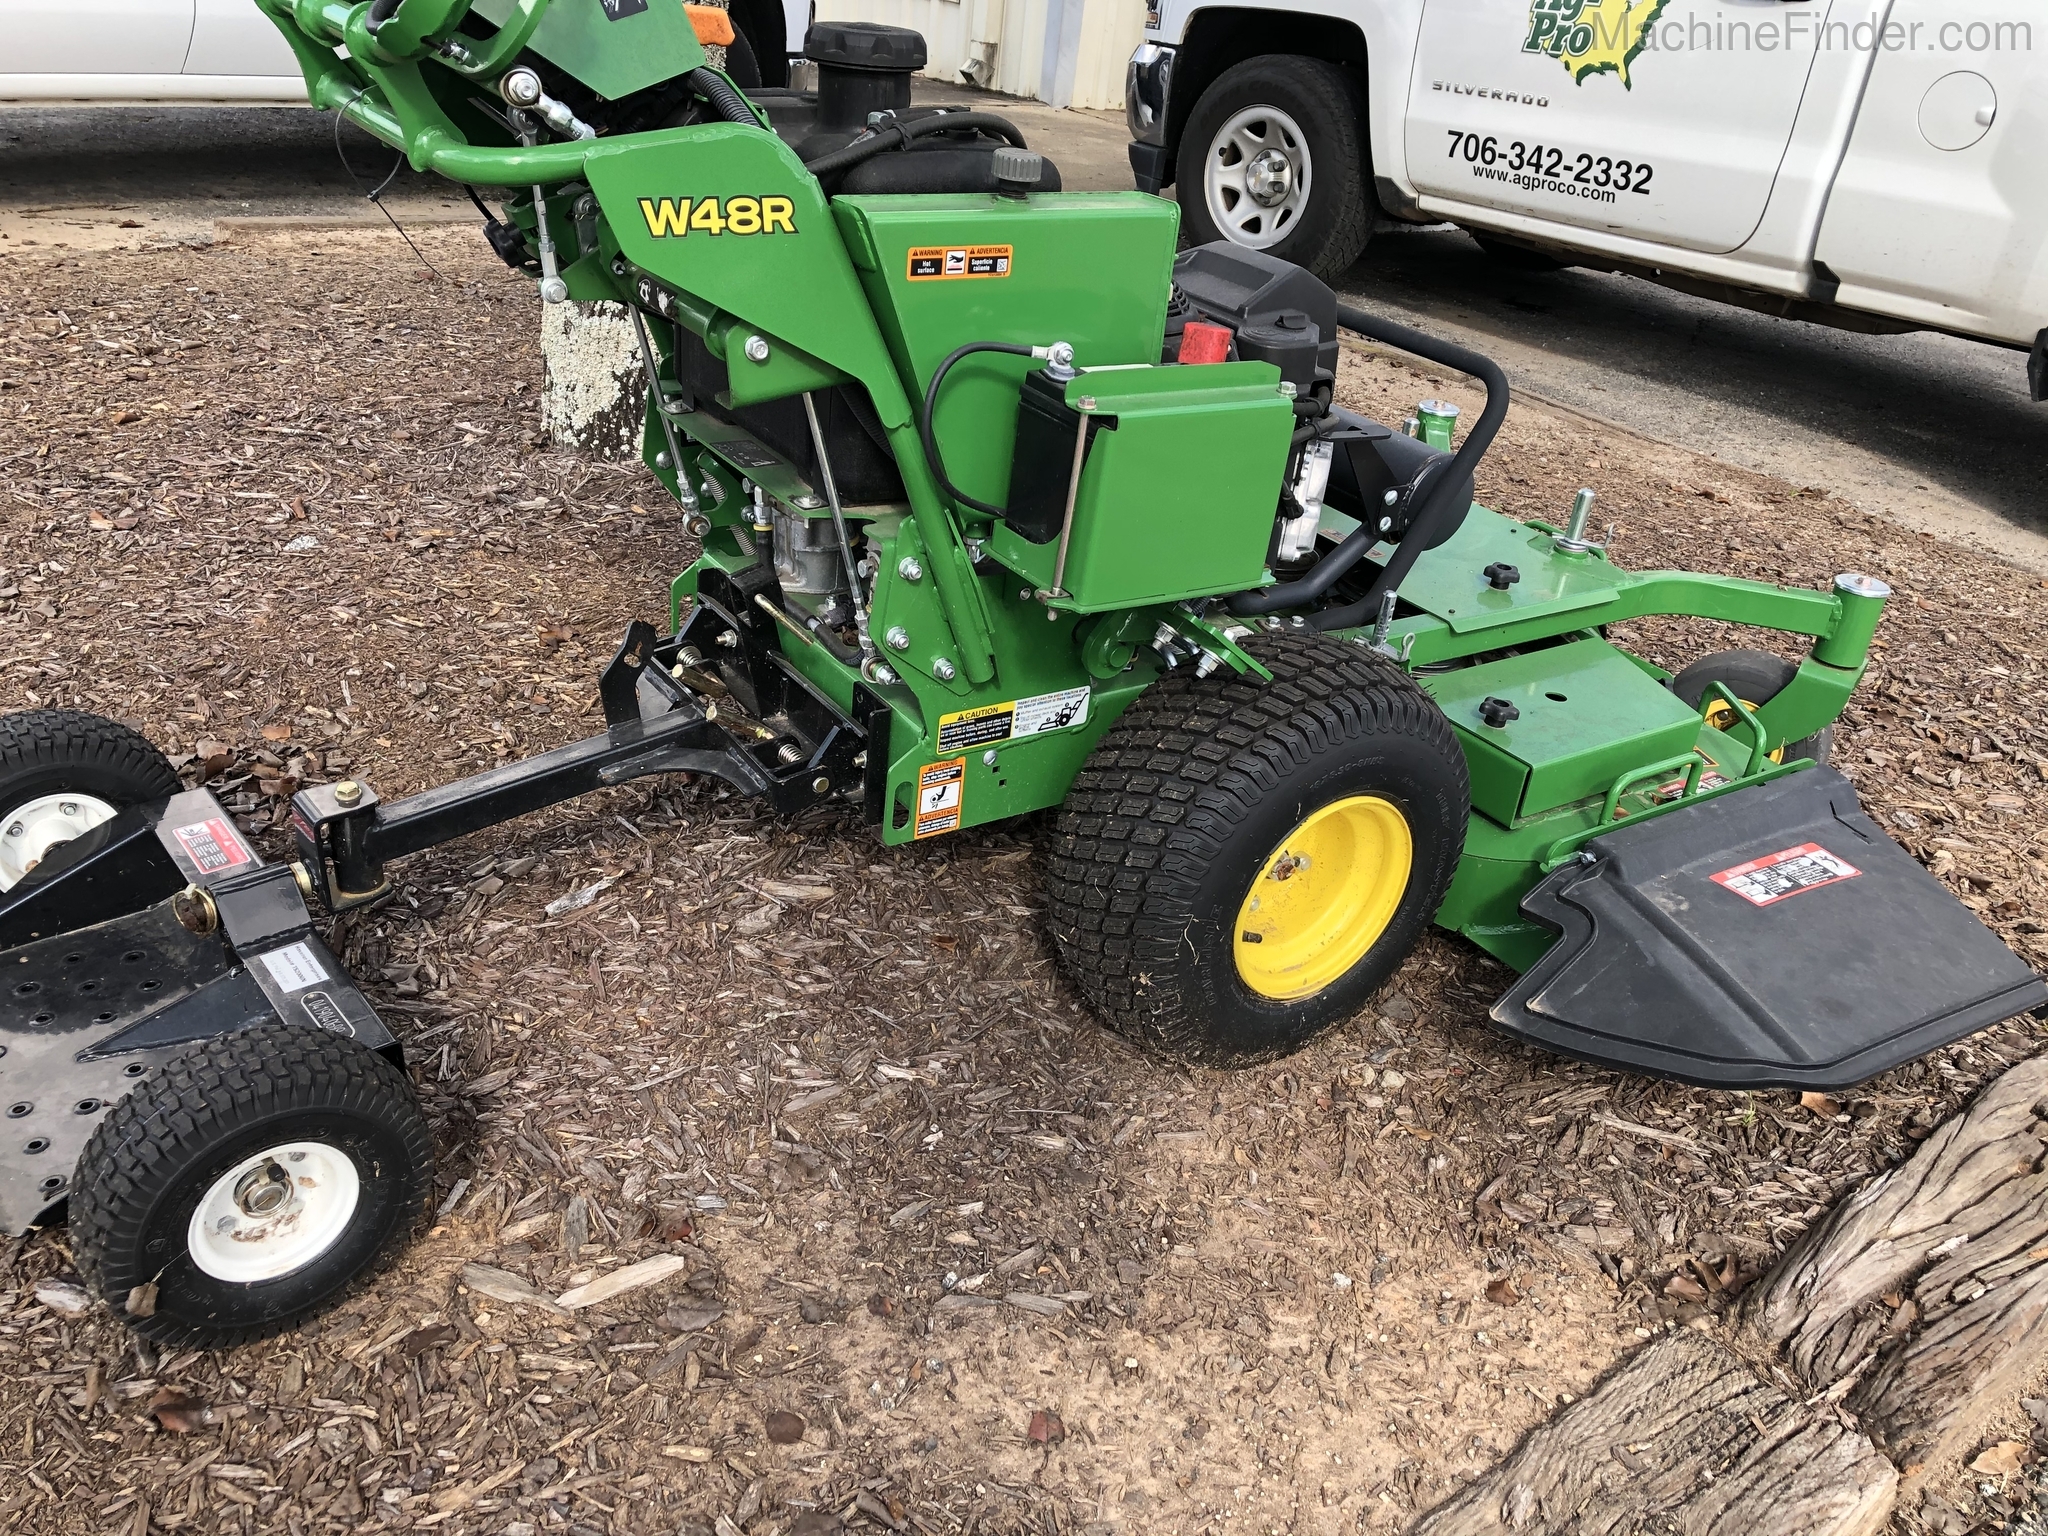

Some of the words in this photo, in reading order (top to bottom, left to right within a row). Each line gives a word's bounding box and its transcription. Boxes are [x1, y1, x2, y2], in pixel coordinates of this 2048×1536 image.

[1522, 12, 1594, 56] Pro
[1432, 79, 1550, 107] SILVERADO
[1447, 129, 1653, 194] 706-342-2332
[1473, 165, 1616, 203] www.agproco.com
[637, 195, 799, 238] W48R
[976, 247, 1008, 255] ADVERTENCIA
[971, 258, 993, 266] Superficie
[965, 706, 998, 719] CAUTION
[933, 760, 958, 770] WARNING
[924, 808, 958, 820] ADVERTENCIA
